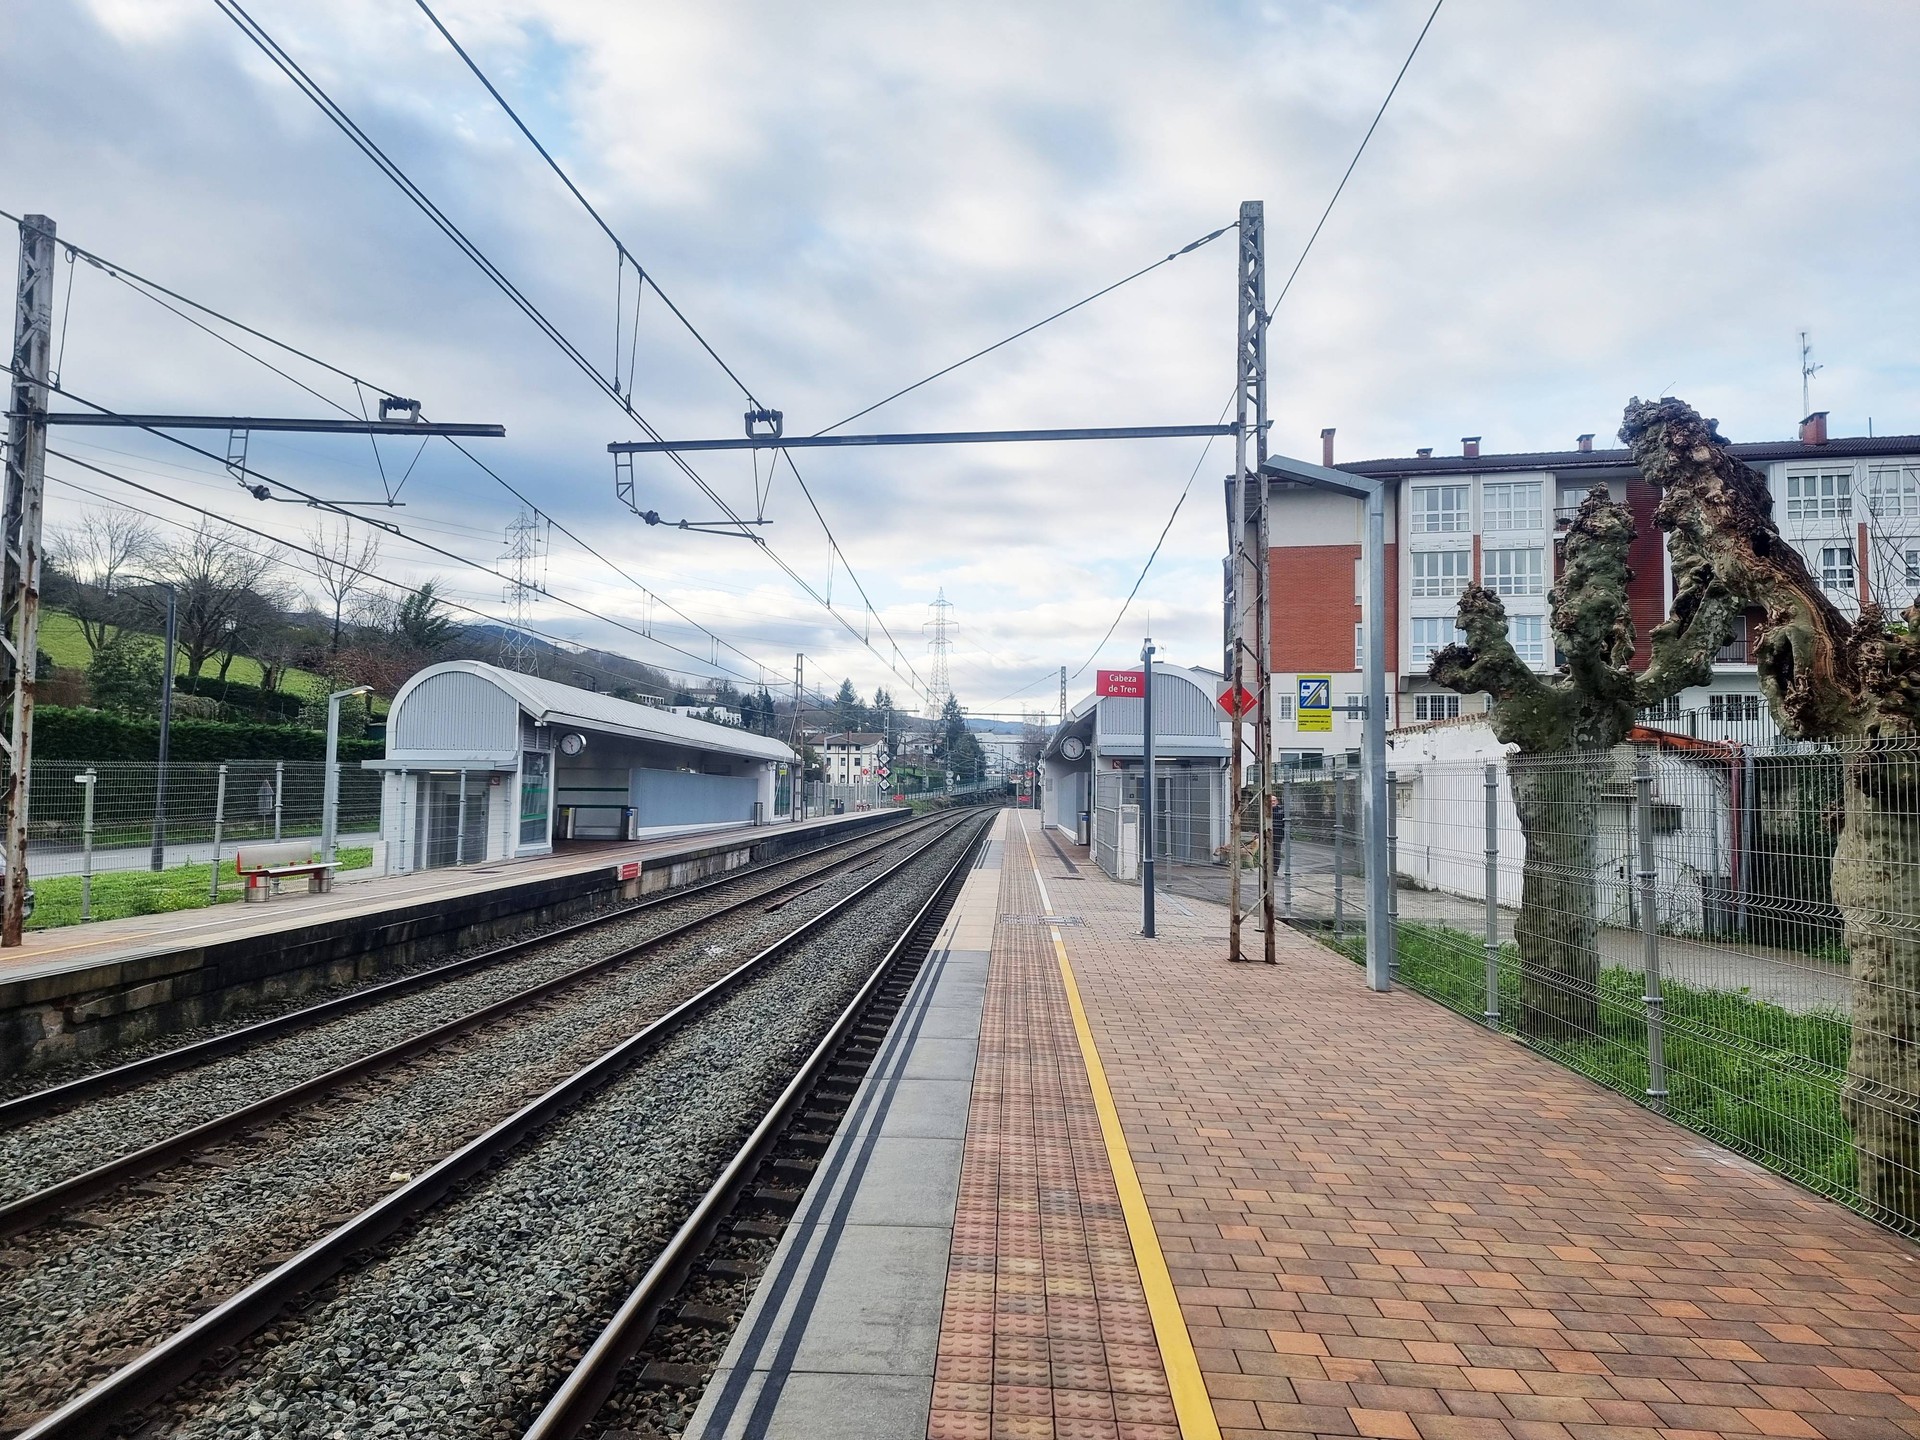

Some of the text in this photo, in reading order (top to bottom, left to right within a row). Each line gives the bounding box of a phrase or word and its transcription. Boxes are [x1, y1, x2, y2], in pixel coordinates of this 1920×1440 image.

[1109, 674, 1137, 683] Cabeza
[1108, 685, 1137, 693] de Tren
